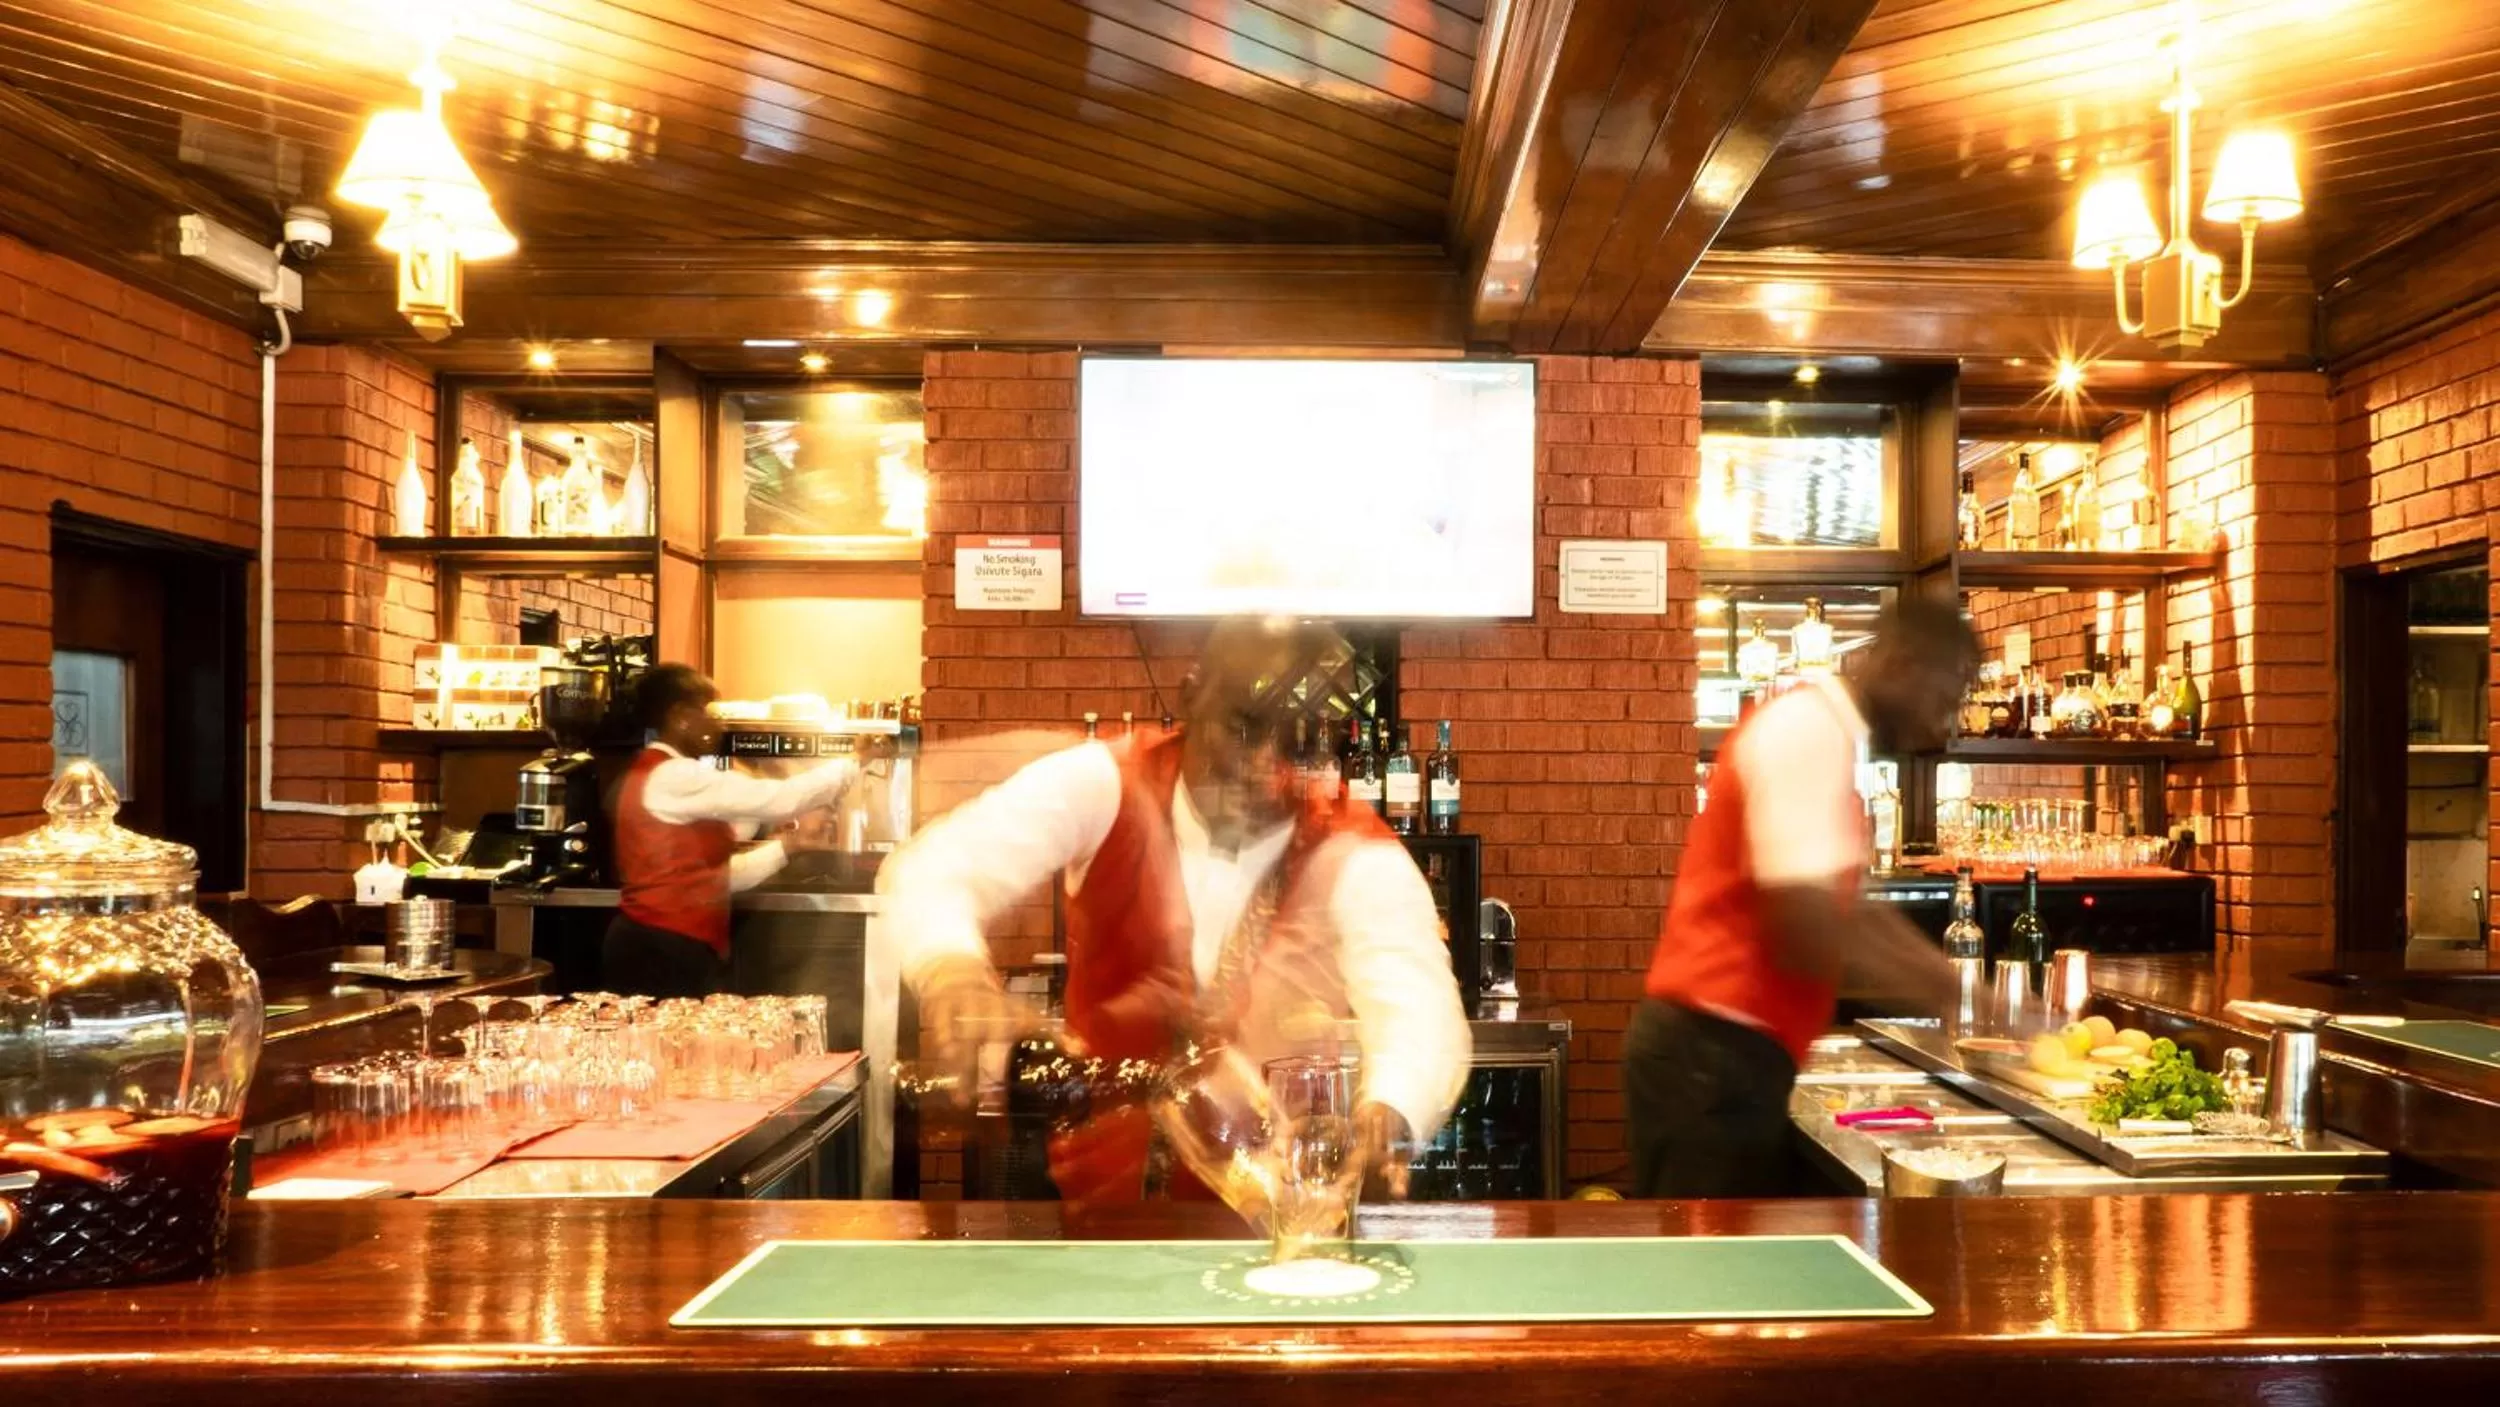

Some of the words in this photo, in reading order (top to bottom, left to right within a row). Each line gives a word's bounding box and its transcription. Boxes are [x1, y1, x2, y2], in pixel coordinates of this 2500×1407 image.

[983, 554, 996, 564] No
[996, 553, 1036, 567] Smoking
[1012, 565, 1042, 580] Sigara
